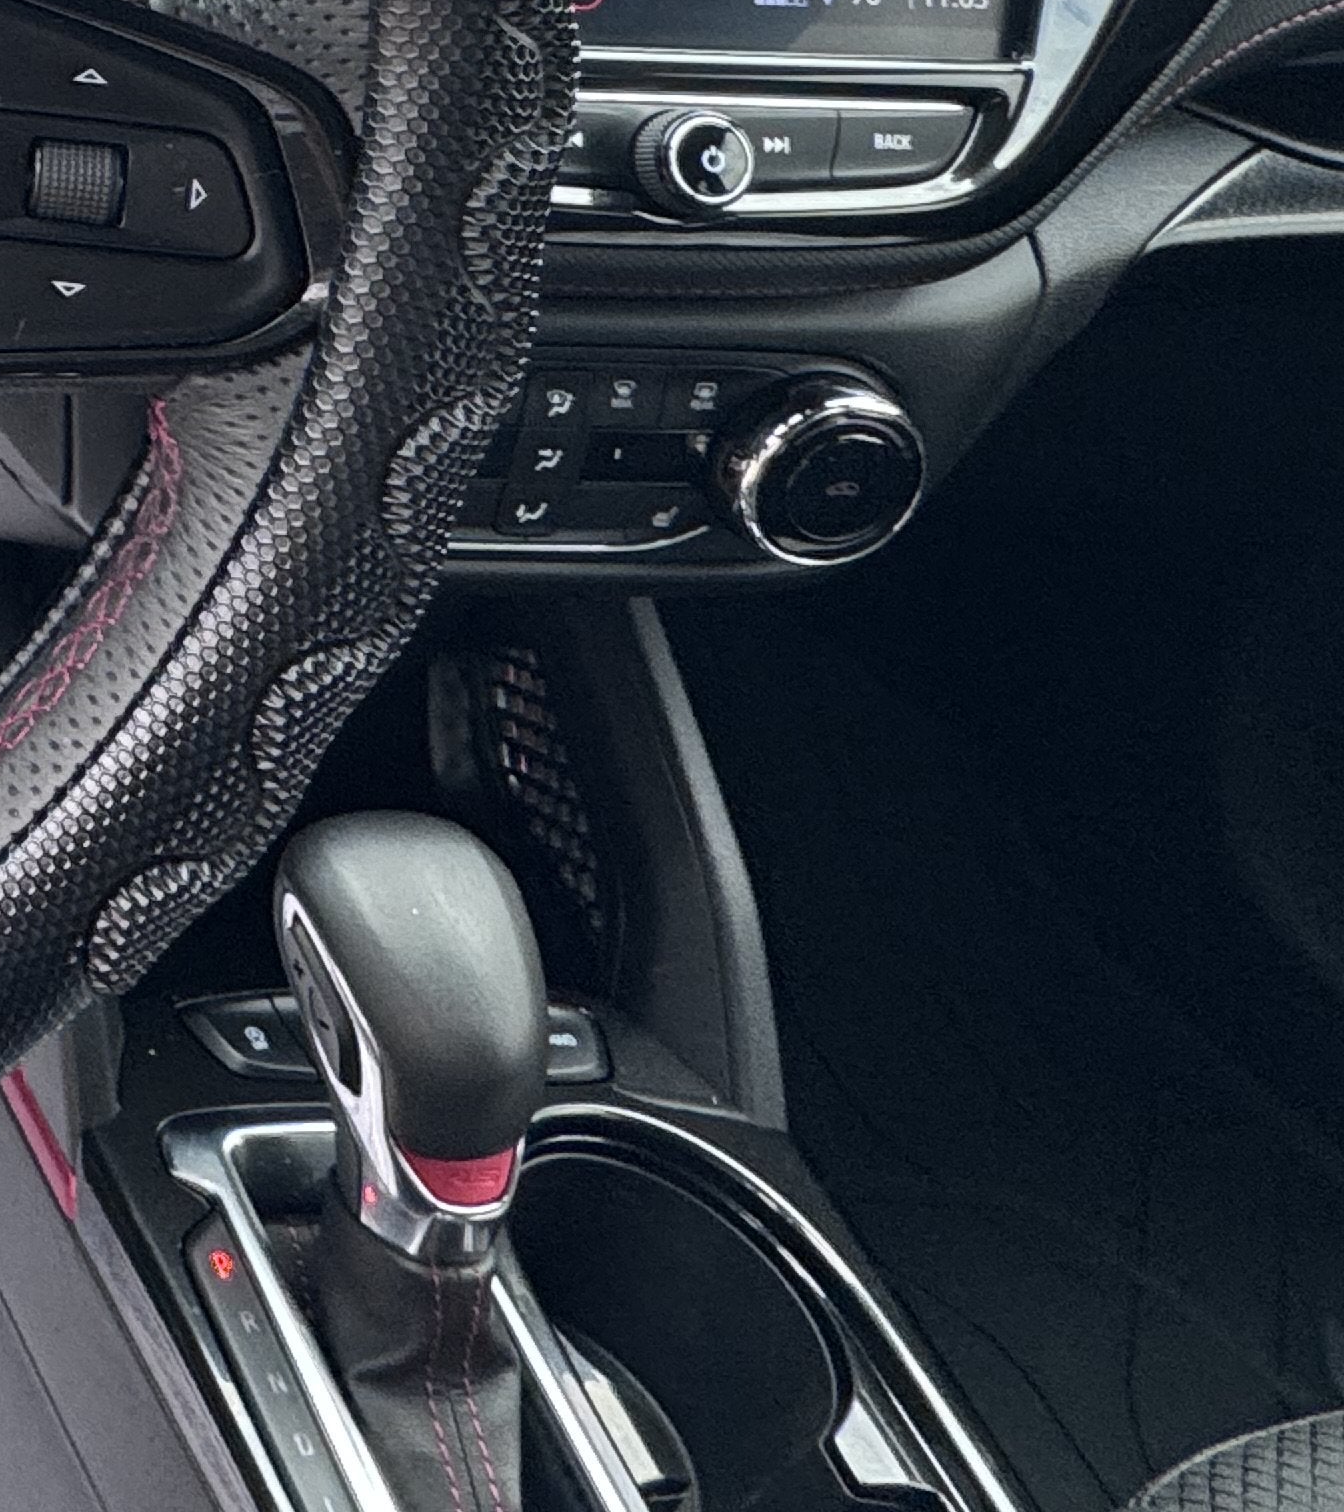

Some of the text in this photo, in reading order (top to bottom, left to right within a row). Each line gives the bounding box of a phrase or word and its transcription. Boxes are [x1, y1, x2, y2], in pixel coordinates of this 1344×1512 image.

[873, 132, 912, 150] BACK
[209, 1250, 234, 1280] P
[240, 1310, 260, 1334] R
